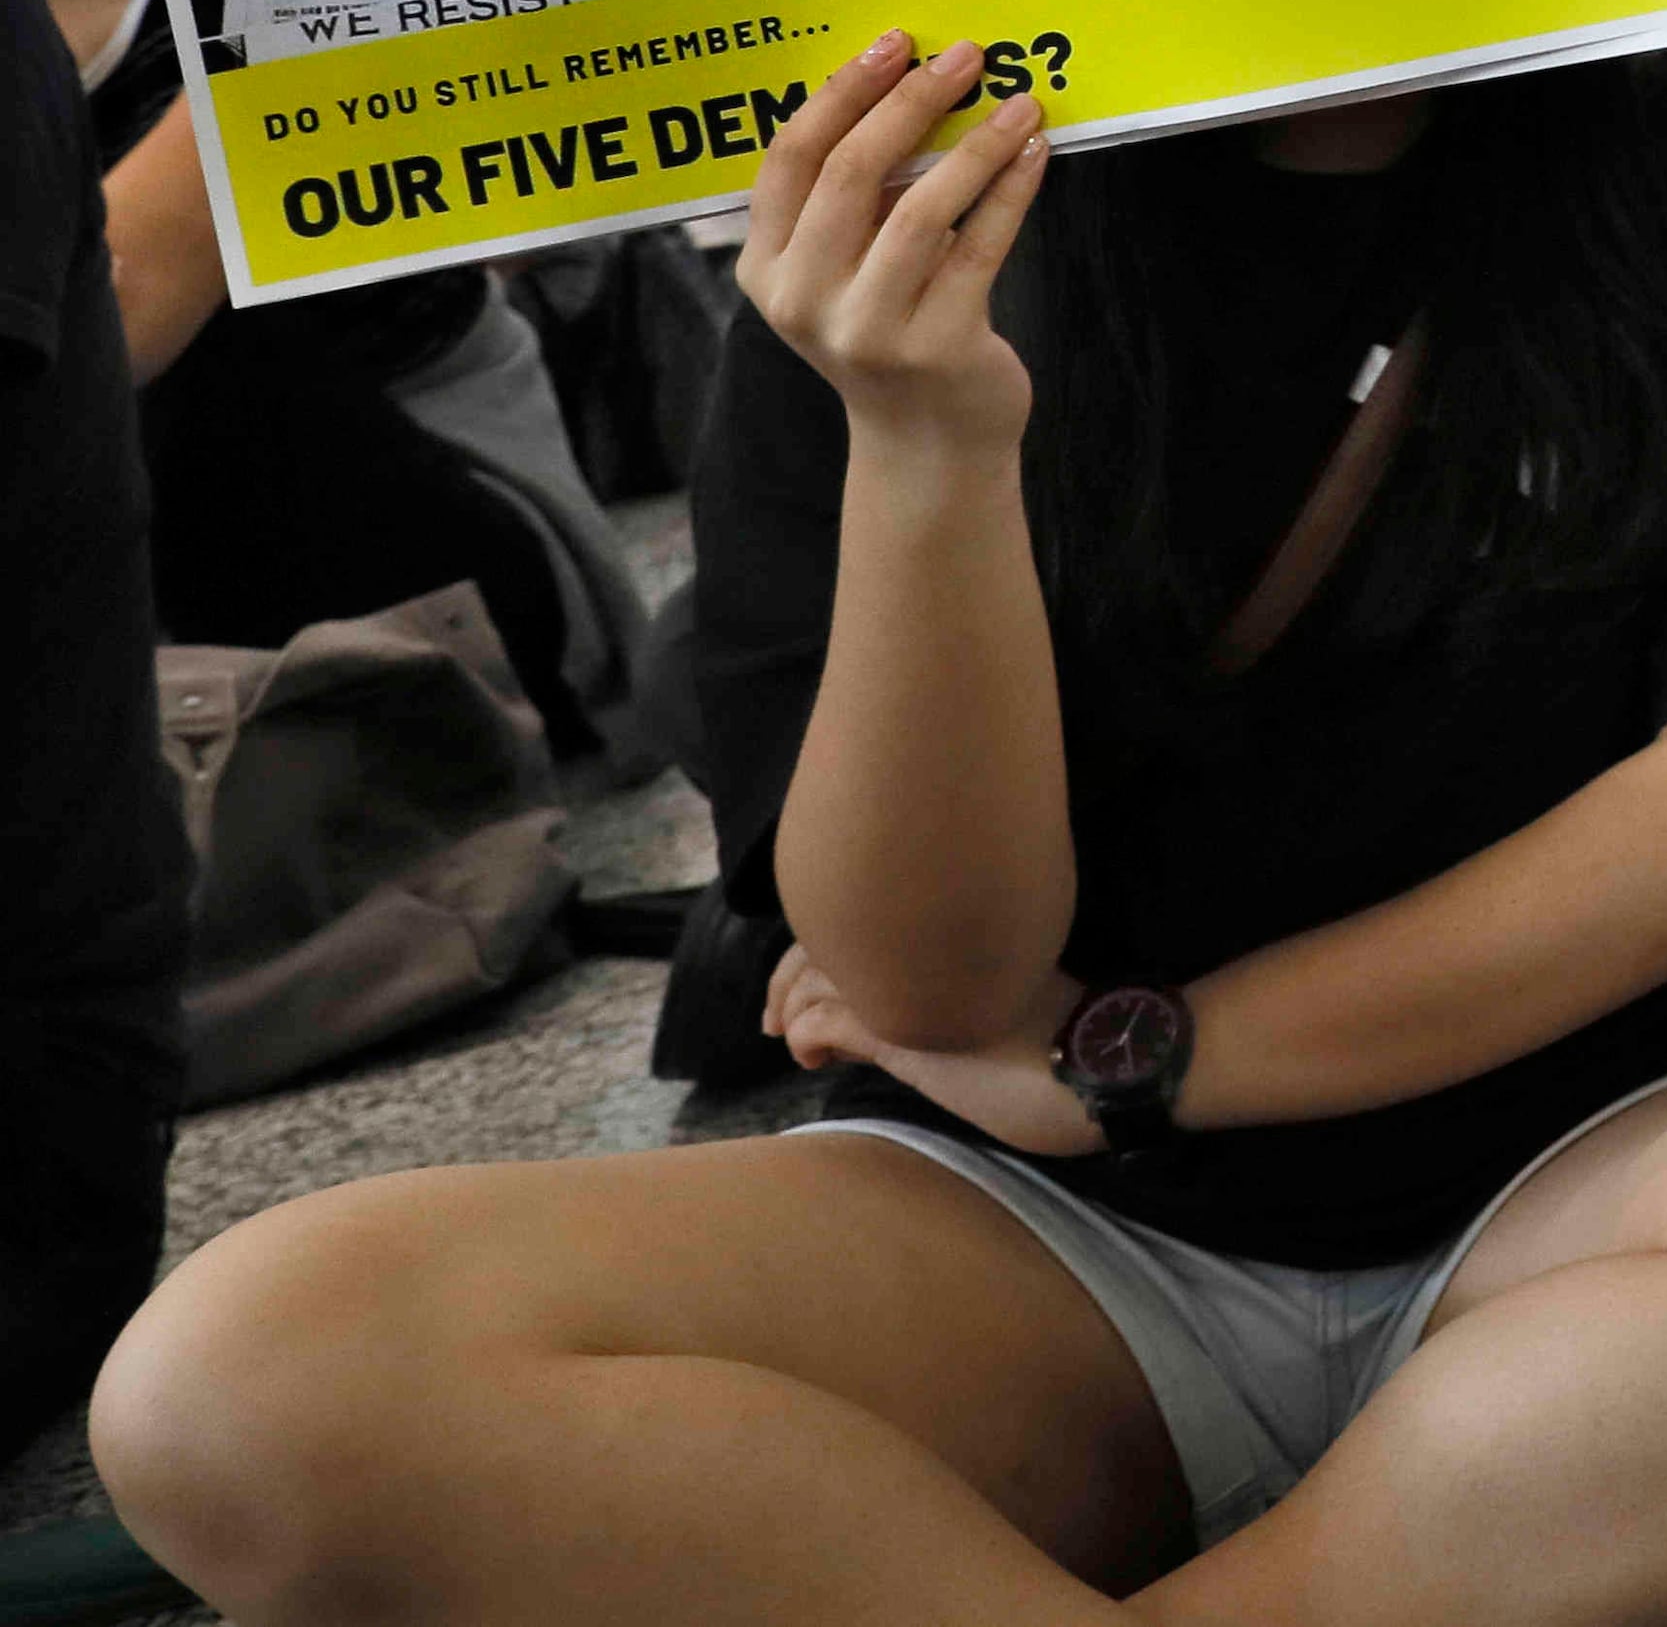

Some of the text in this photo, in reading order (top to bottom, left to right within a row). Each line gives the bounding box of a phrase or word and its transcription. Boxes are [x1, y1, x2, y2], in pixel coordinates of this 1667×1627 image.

[263, 16, 831, 141] DO YOU STILL REMEMBER...
[300, 12, 380, 44] WE
[282, 153, 449, 239] OUR
[461, 116, 638, 206] FIVE
